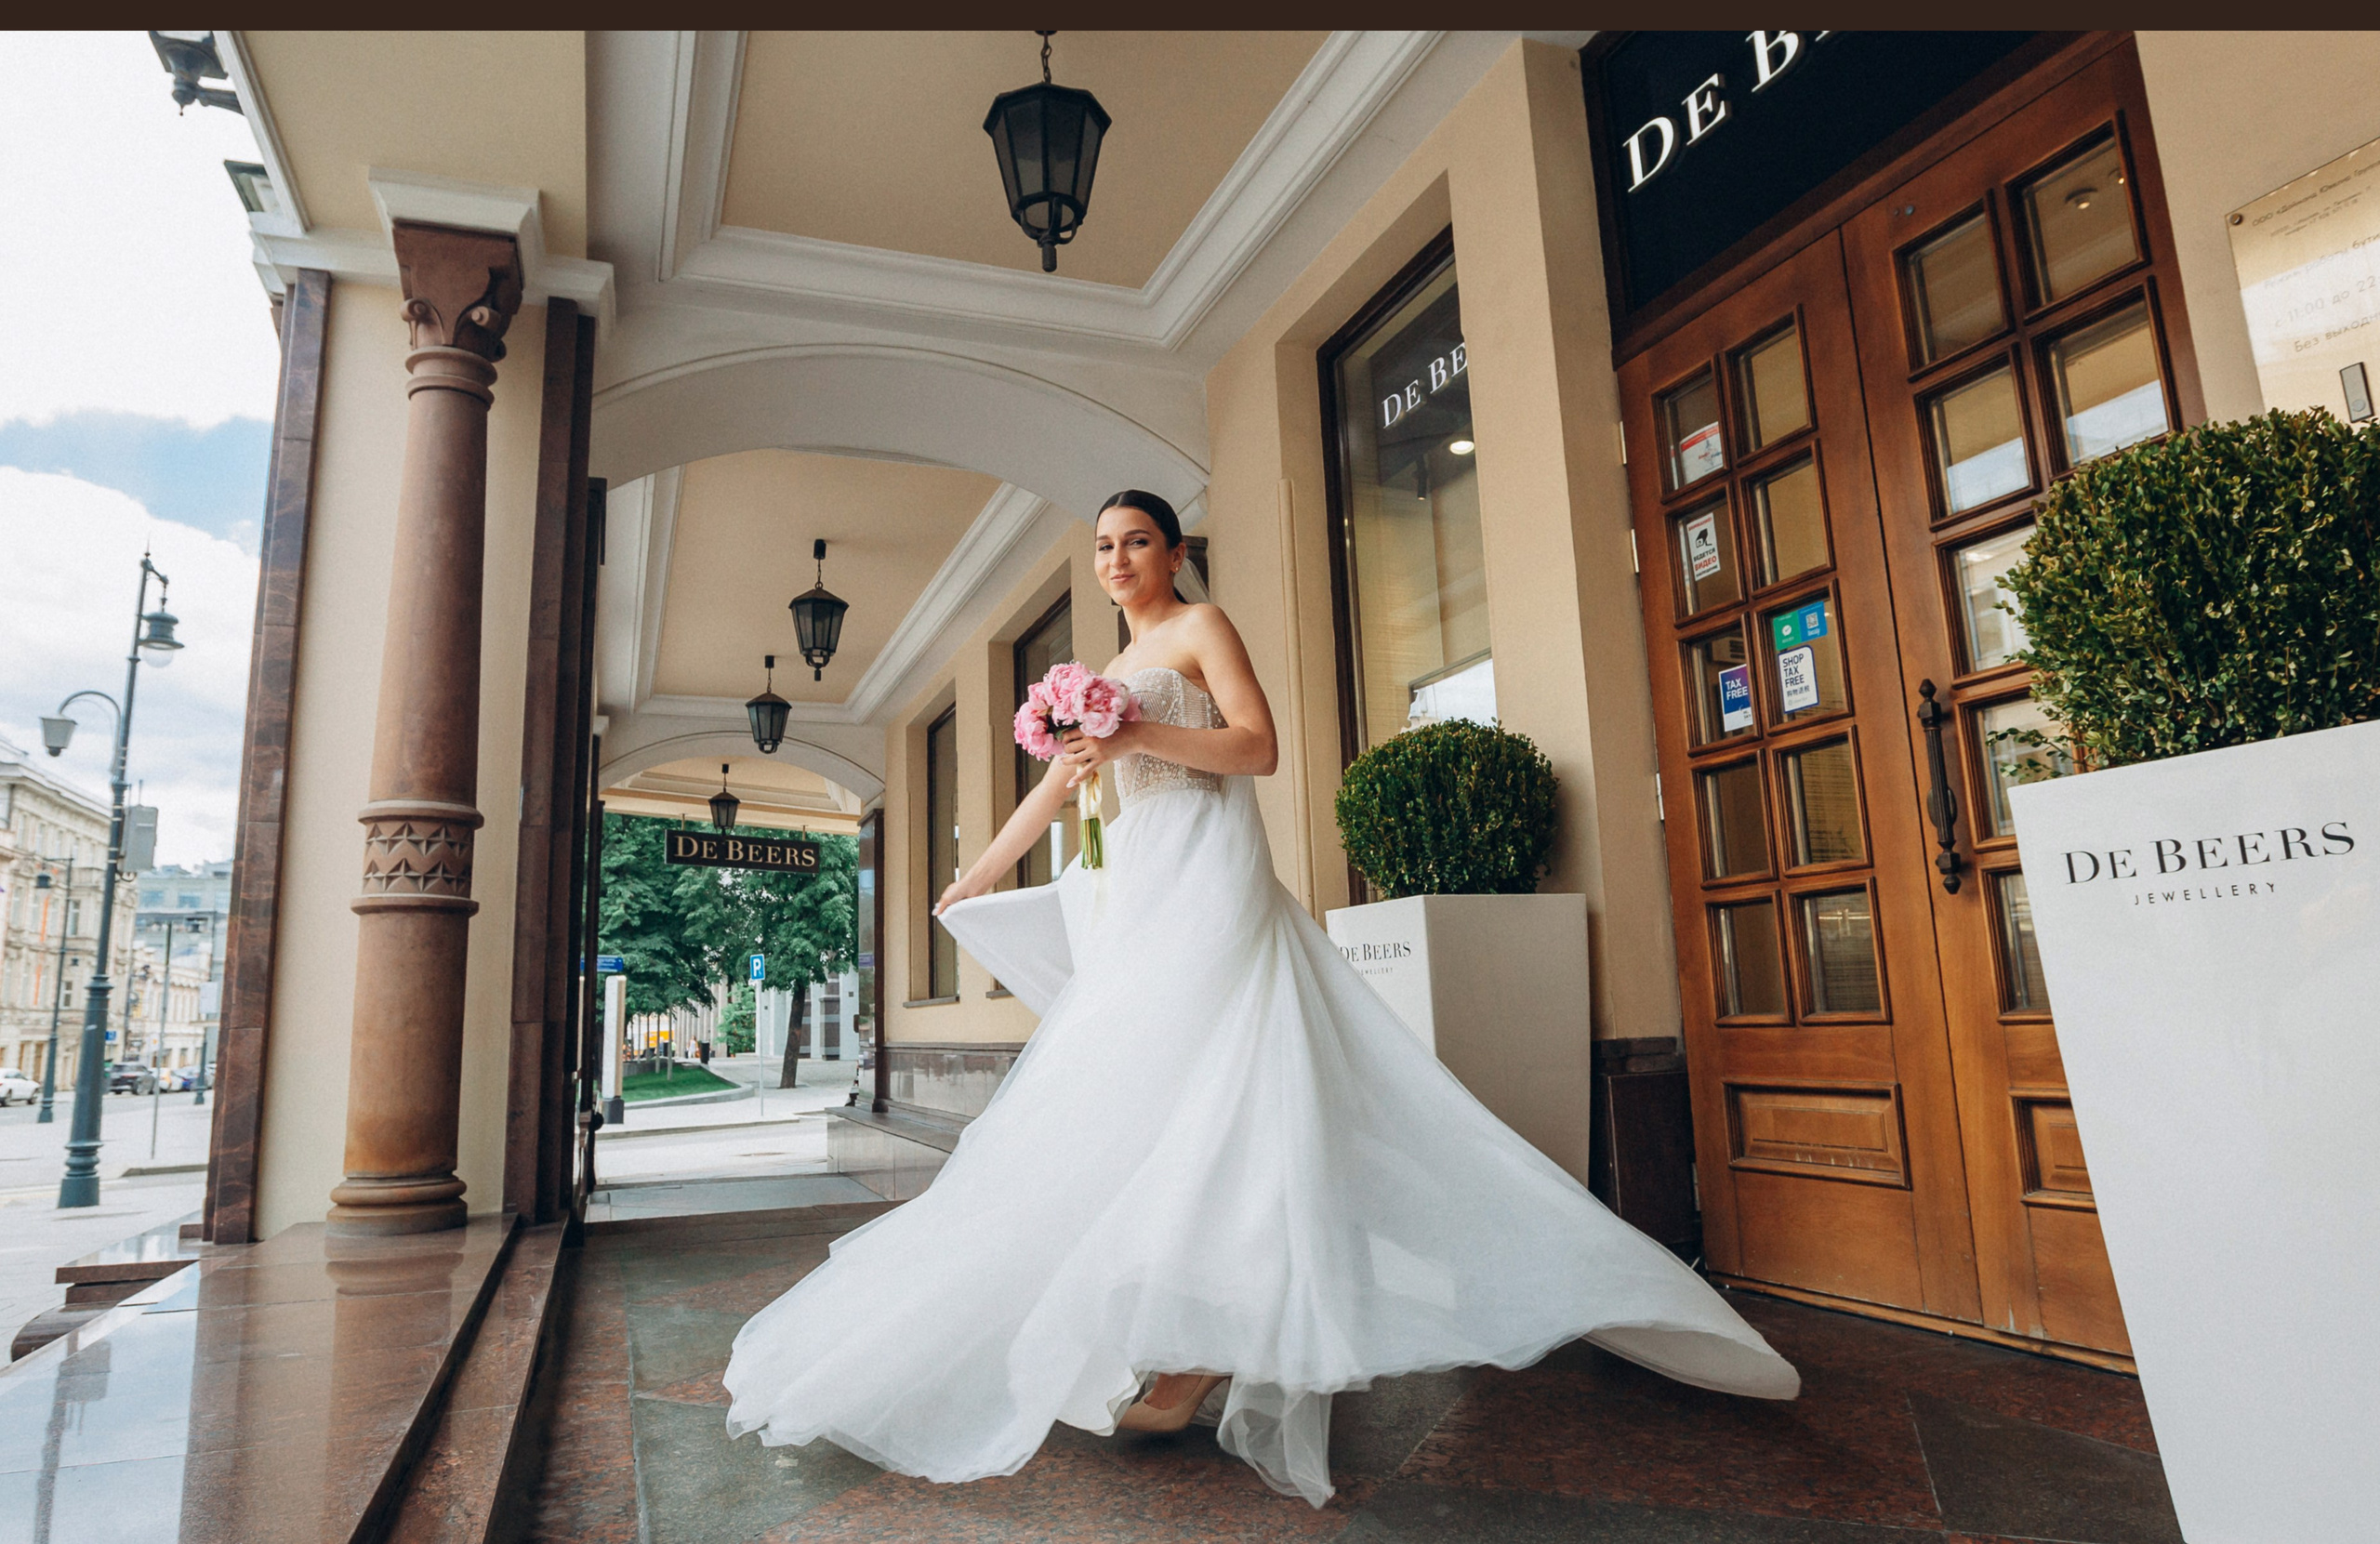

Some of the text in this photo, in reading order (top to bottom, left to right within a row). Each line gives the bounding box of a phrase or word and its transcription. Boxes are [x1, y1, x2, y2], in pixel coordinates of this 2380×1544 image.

[1622, 73, 1726, 192] DE
[2332, 290, 2350, 305] до
[2293, 337, 2320, 353] Без
[1382, 379, 1421, 429] DE
[1695, 555, 1717, 571] ВИДЕО
[1782, 653, 1805, 667] SHOP
[1783, 665, 1799, 678] TAX
[1725, 678, 1742, 690] TAX
[1784, 674, 1805, 688] FREE
[1726, 686, 1748, 701] FREE
[673, 836, 815, 866] DE BEERS
[2060, 822, 2355, 884] DE BEERS
[2135, 883, 2275, 905] JEWELLERY
[1362, 941, 1411, 961] BEERS
[753, 957, 762, 977] P
